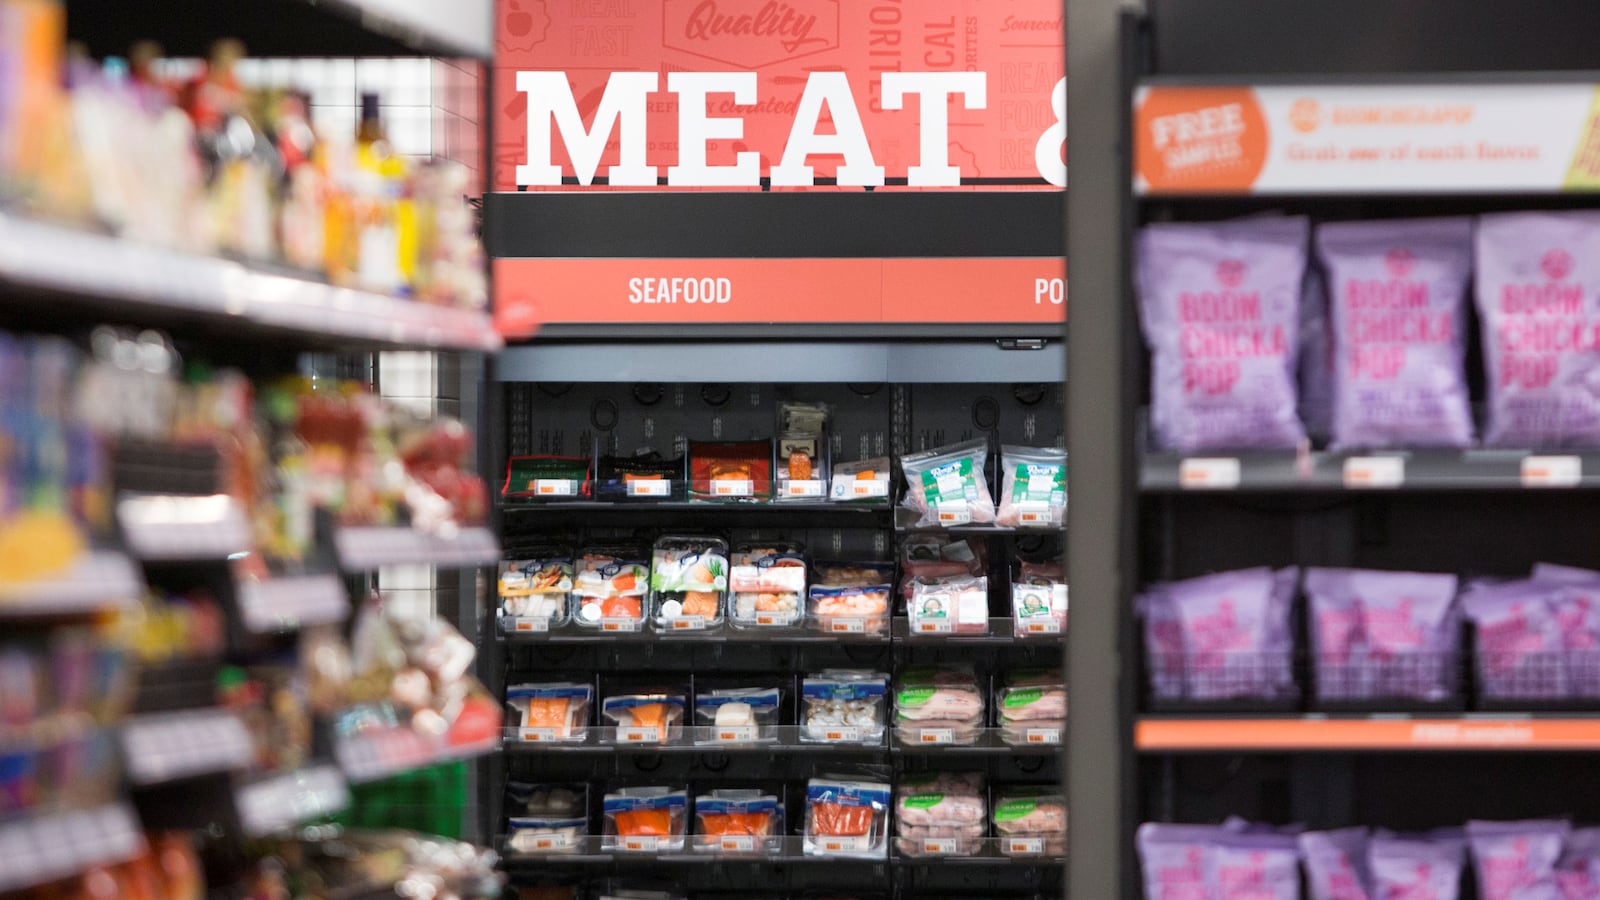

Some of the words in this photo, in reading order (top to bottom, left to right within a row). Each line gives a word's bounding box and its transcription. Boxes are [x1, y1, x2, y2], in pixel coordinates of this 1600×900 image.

[684, 0, 830, 54] Quality
[516, 70, 987, 187] MEAT
[1150, 103, 1246, 151] FREE
[628, 277, 733, 305] SEAFOOD
